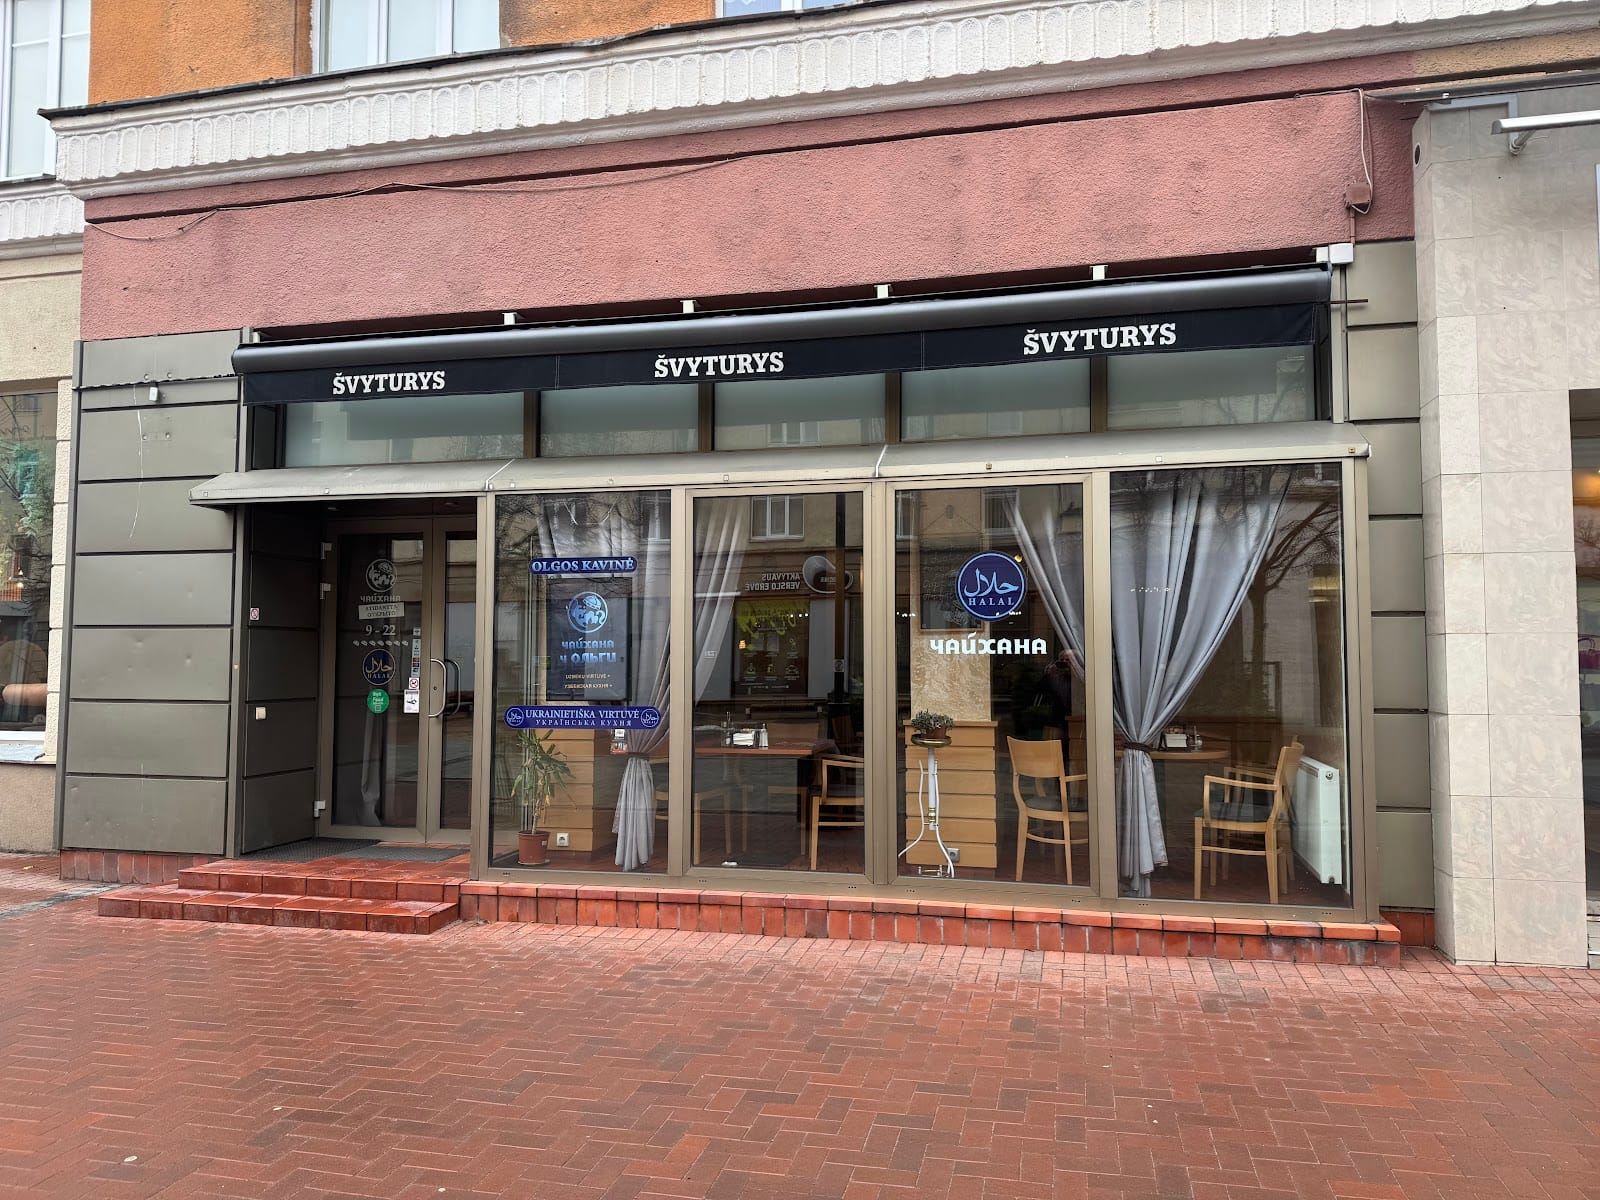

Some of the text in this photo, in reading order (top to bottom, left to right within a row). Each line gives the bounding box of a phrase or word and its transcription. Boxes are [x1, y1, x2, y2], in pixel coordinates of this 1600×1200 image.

[1023, 322, 1177, 356] ŠVYTURYS
[654, 351, 784, 378] ŠVYTURYS
[332, 370, 446, 396] ŠVYTURYS
[531, 557, 635, 572] OLGOS KAVINĖ
[968, 597, 1015, 606] HALAL
[365, 624, 373, 636] 9
[382, 624, 396, 636] 22
[562, 637, 615, 649] ЧАЙХАНА
[929, 631, 1048, 655] ЧАЙХАНА
[525, 707, 640, 719] UKRAINIETIŠKA VIRTUVĖ
[600, 719, 632, 727] КУХНЯ
